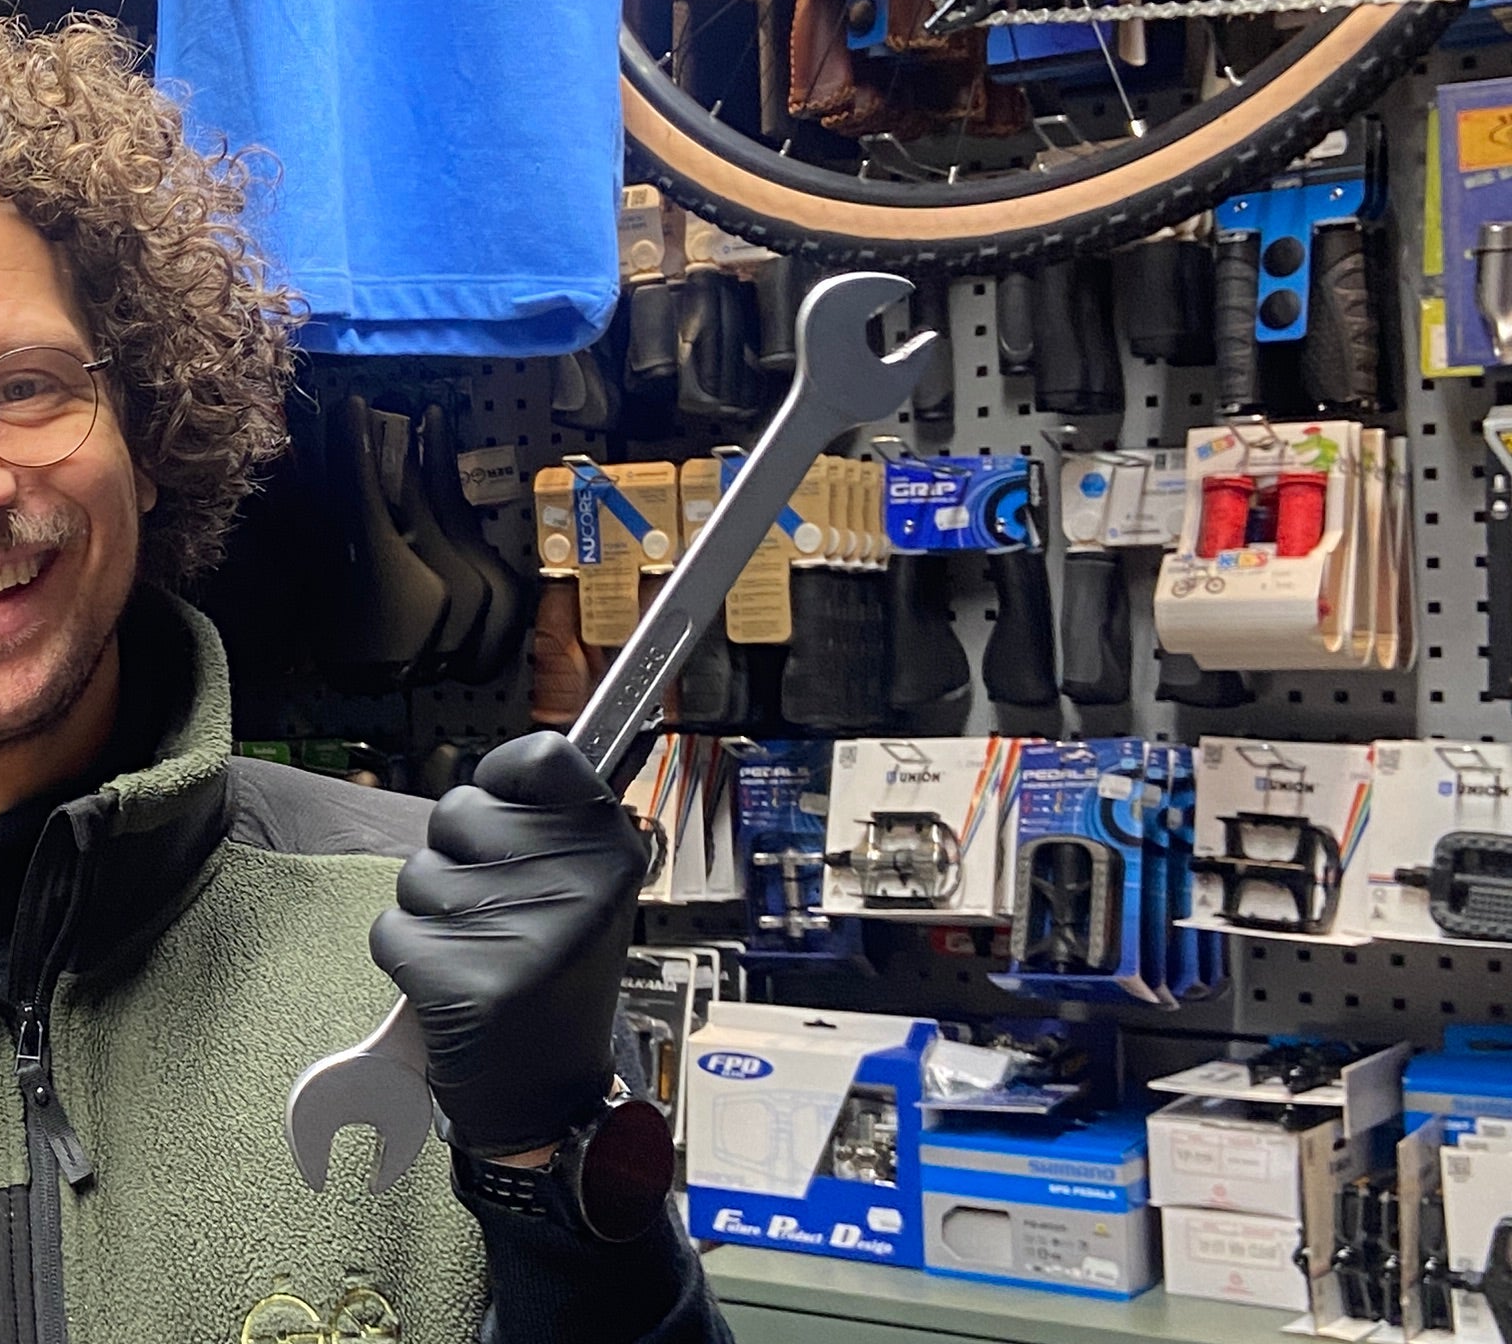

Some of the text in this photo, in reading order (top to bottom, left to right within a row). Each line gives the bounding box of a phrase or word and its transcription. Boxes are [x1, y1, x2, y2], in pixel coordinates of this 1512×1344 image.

[578, 487, 597, 564] NUCORE
[898, 770, 942, 783] UNION
[705, 1054, 762, 1073] FPD
